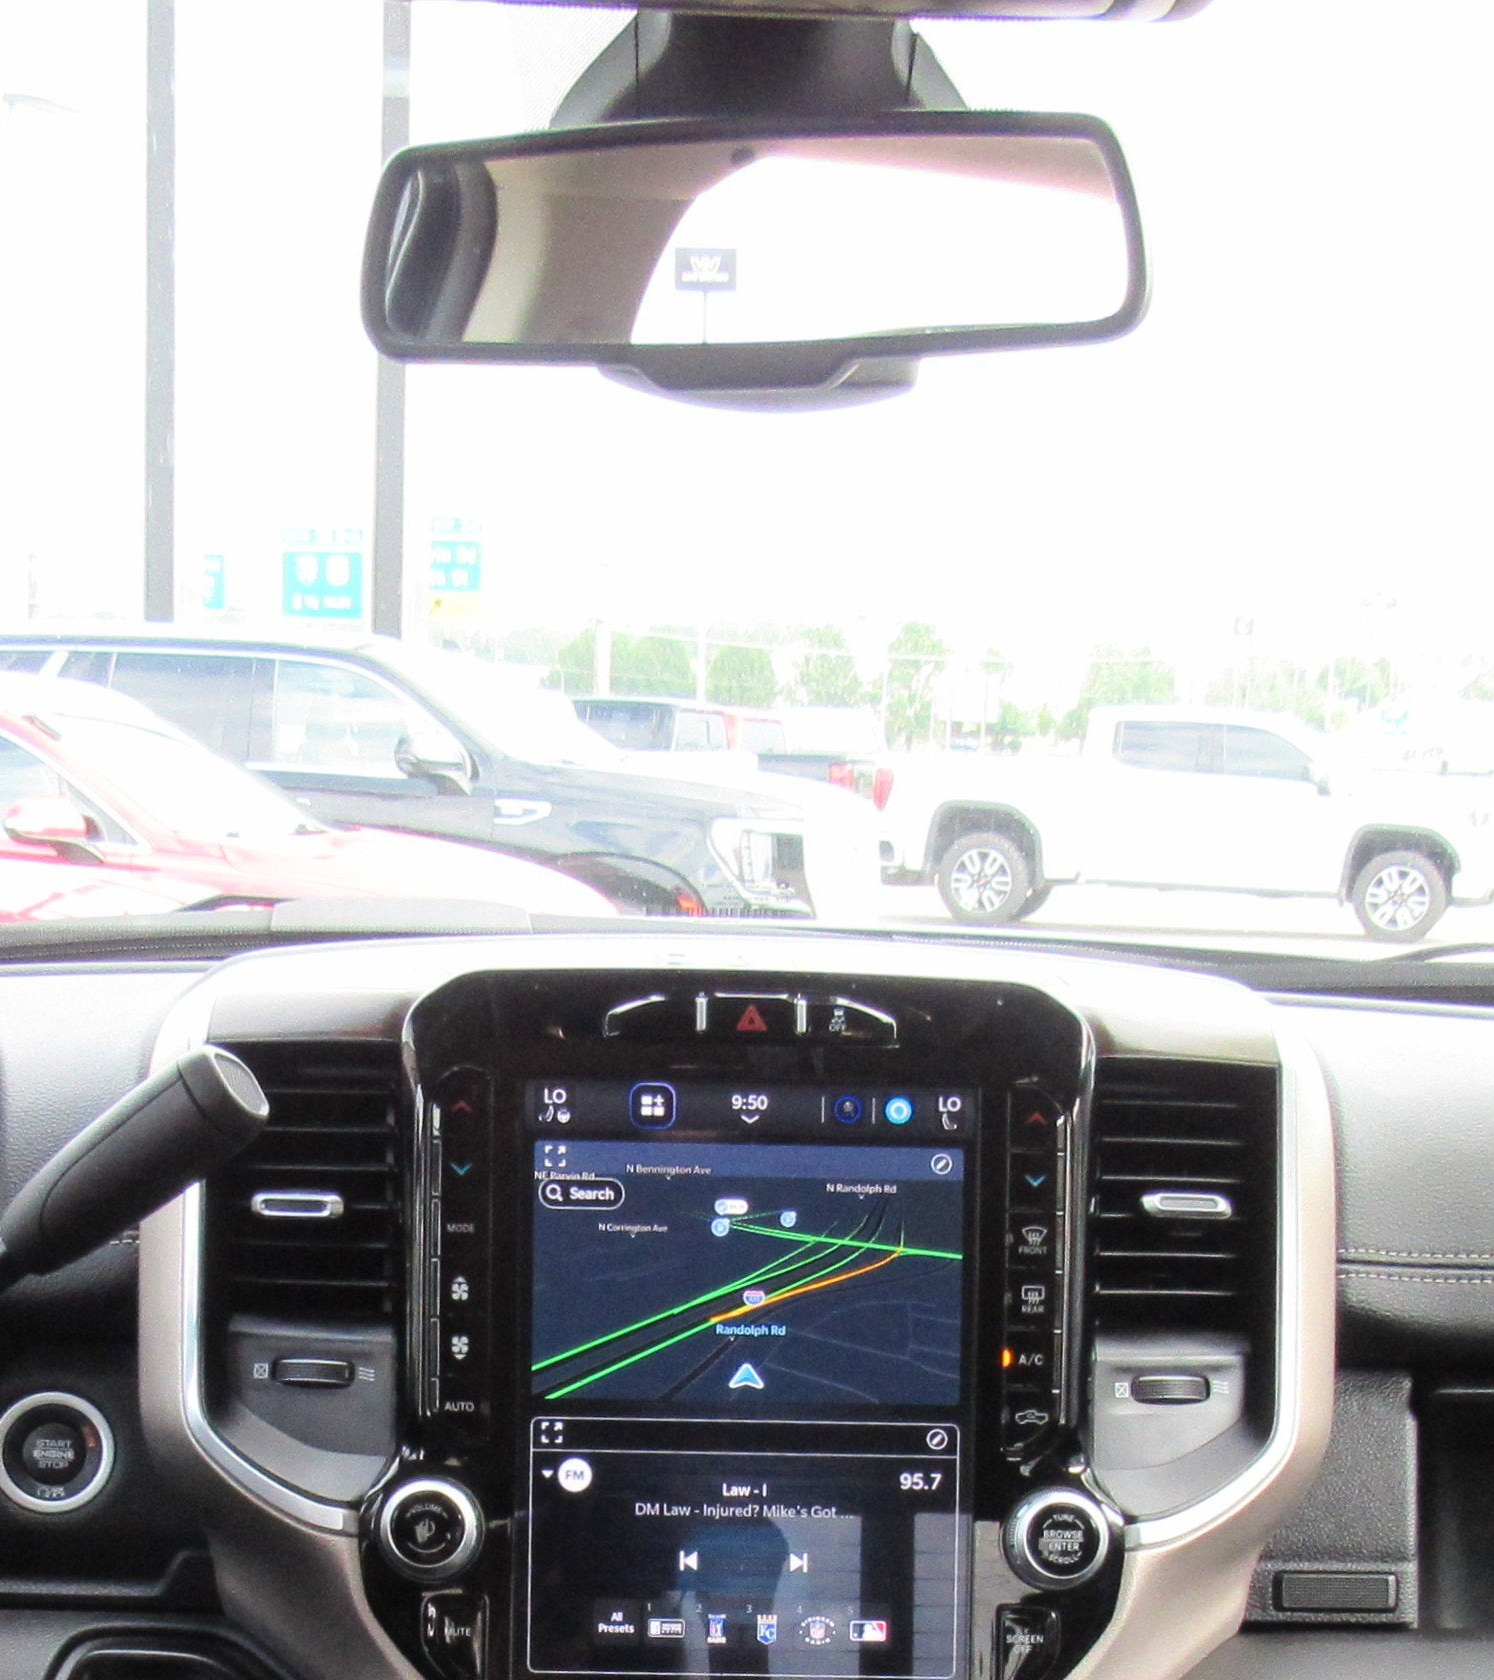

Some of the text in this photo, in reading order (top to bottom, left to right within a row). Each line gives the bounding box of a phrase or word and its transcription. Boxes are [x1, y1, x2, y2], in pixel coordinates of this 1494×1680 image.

[543, 1088, 567, 1105] LO
[731, 1094, 769, 1112] 9:50
[938, 1096, 962, 1112] LO
[636, 1164, 691, 1176] Bennington
[693, 1165, 711, 1175] Ave
[569, 1187, 615, 1201] Search
[836, 1183, 882, 1195] Randolph
[884, 1184, 897, 1194] Rd
[1018, 1246, 1047, 1255] FRONT
[1021, 1305, 1044, 1313] REAR
[716, 1324, 786, 1337] Randolph Rd
[1018, 1354, 1044, 1366] A/C
[444, 1402, 475, 1412] AUTO
[565, 1470, 585, 1481] FM
[900, 1472, 943, 1491] 95.7
[722, 1483, 750, 1497] Law
[635, 1503, 660, 1516] DM
[663, 1503, 691, 1516] Law
[703, 1504, 759, 1520] Injured?
[763, 1505, 808, 1518] Mike's
[810, 1506, 837, 1519] Got
[1043, 1530, 1084, 1539] BROWSE
[1048, 1542, 1080, 1551] ENTER
[610, 1612, 623, 1622] All
[598, 1623, 635, 1634] Presets
[1006, 1634, 1044, 1644] SCREEN
